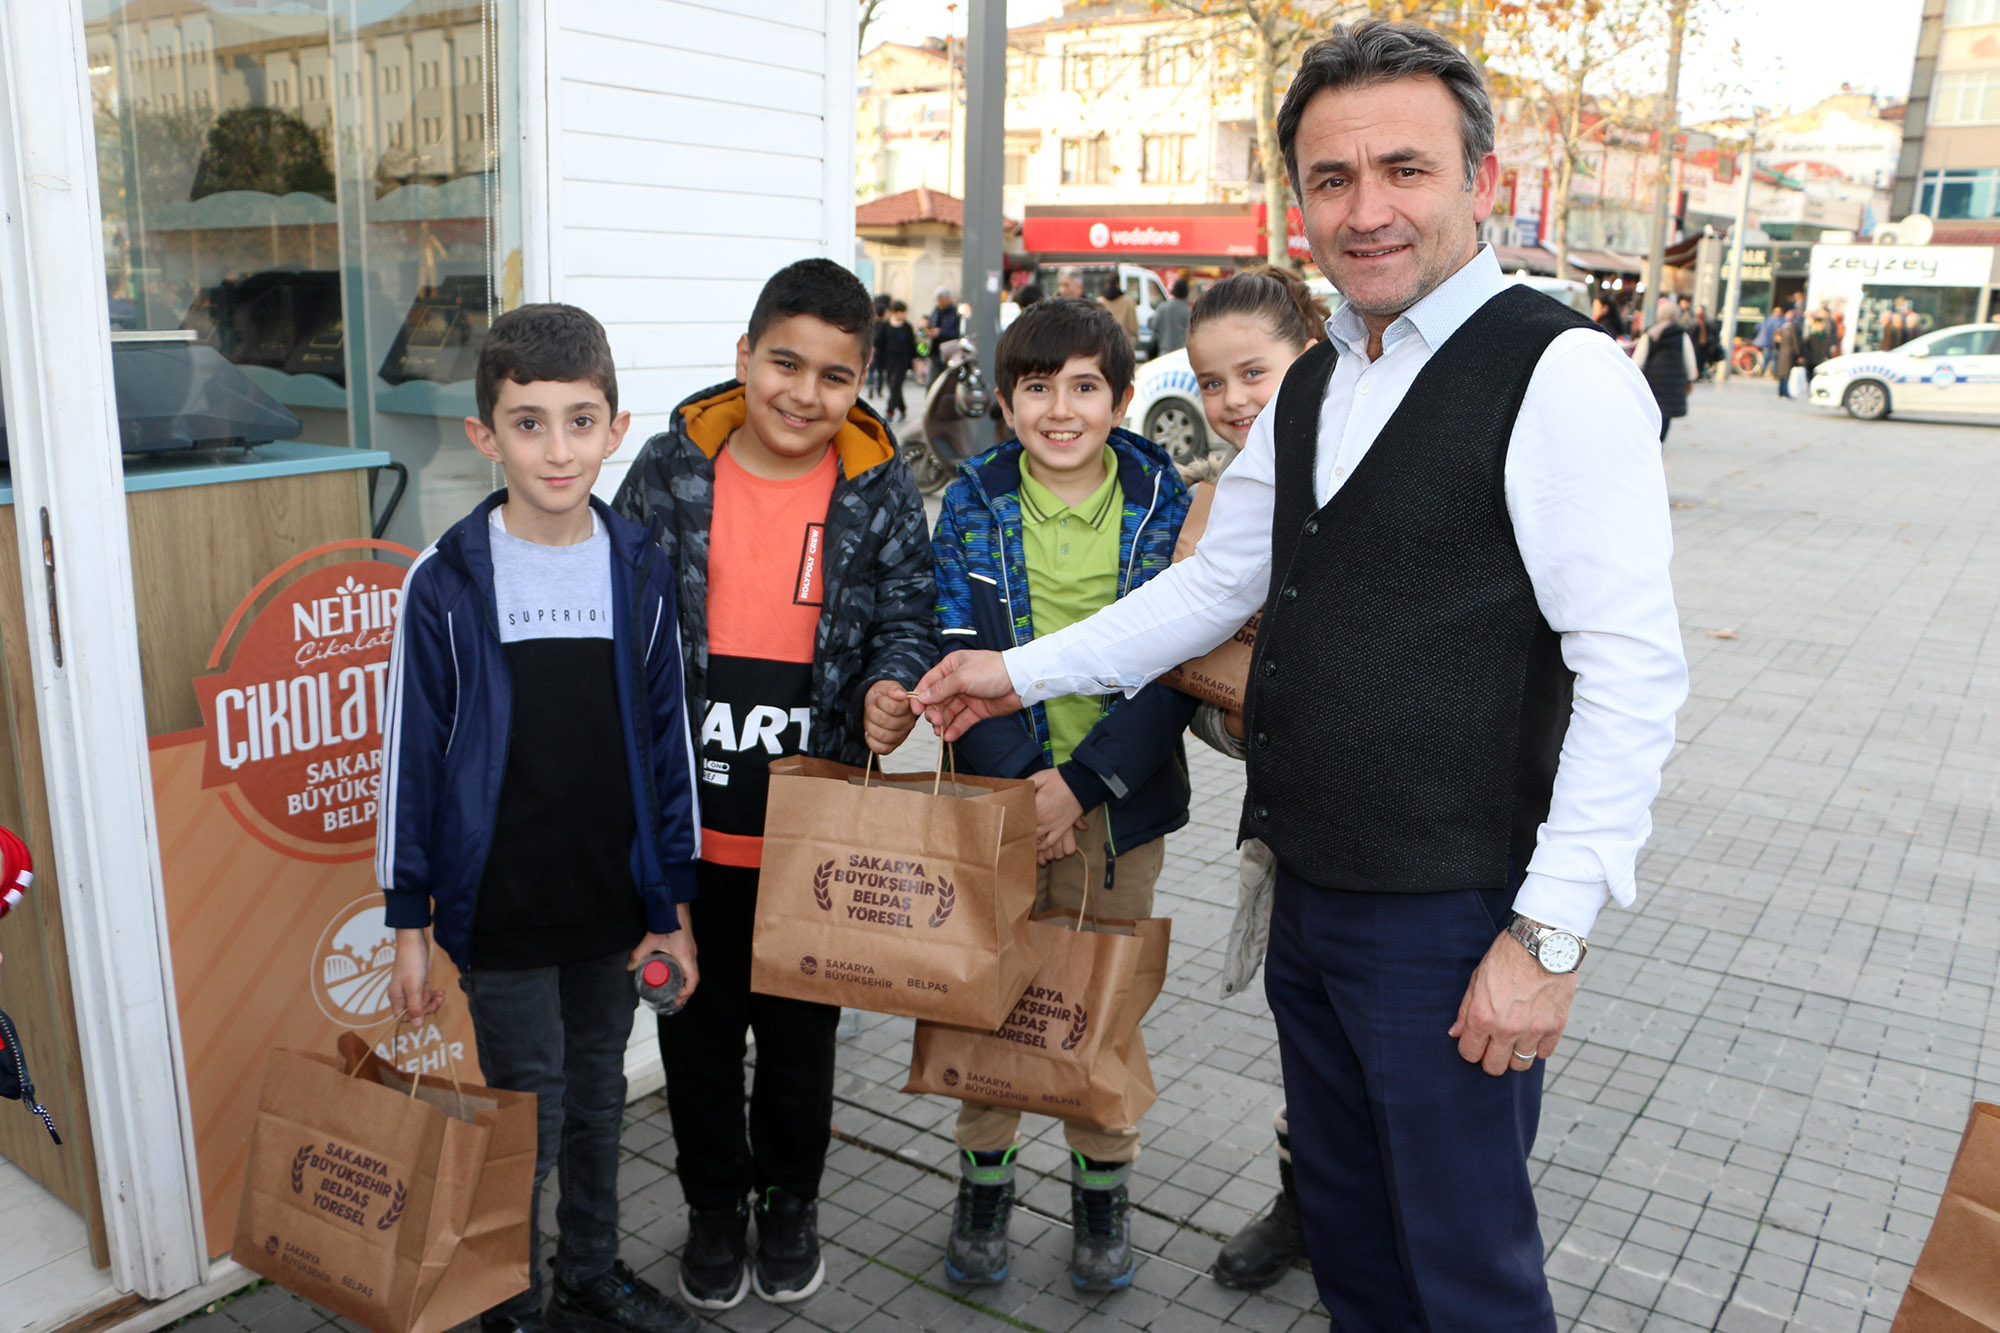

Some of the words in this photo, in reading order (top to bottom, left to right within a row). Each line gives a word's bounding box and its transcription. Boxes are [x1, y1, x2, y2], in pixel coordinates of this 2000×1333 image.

[1110, 226, 1180, 246] vodafone
[1827, 257, 1938, 278] zeyzey
[801, 556, 815, 599] ROLYPOLY
[809, 529, 819, 554] CREW
[292, 584, 402, 641] NEHİR
[1189, 682, 1241, 710] BÜYÜKŞEH
[1191, 671, 1237, 697] SAKARYA
[215, 661, 389, 769] ÇİKOLAT
[701, 700, 810, 754] ART
[306, 750, 382, 784] SAKAR
[287, 775, 380, 815] BÜYÜKŞ
[323, 801, 378, 832] BELP
[849, 854, 925, 877] SAKARYA
[834, 868, 935, 896] BÜYÜKŞEHİR
[853, 889, 912, 912] BELPAŞ
[846, 905, 914, 929] YÖRESEL
[825, 958, 875, 975] SAKARYA
[824, 970, 893, 989] BÜYÜKŞEHİR
[907, 978, 948, 994] BELPAŞ
[1023, 985, 1064, 1004] ARYA
[1018, 999, 1071, 1021] KŞEHİR
[376, 1024, 442, 1060] ARYA
[996, 1026, 1047, 1049] ÖRESEL
[397, 1041, 464, 1074] EHİR
[965, 1082, 1029, 1102] BÜYÜKŞEHİR
[967, 1071, 1012, 1090] SAKARYA
[1041, 1093, 1081, 1107] BELPAŞ
[325, 1142, 387, 1178] SAKARYA
[310, 1154, 392, 1198] BÜYÜKŞEHİR
[320, 1177, 370, 1208] BELPAŞ
[313, 1192, 365, 1226] YÖRESEL
[284, 1242, 320, 1265] SAKARYA
[341, 1275, 374, 1298] BELPAŞ
